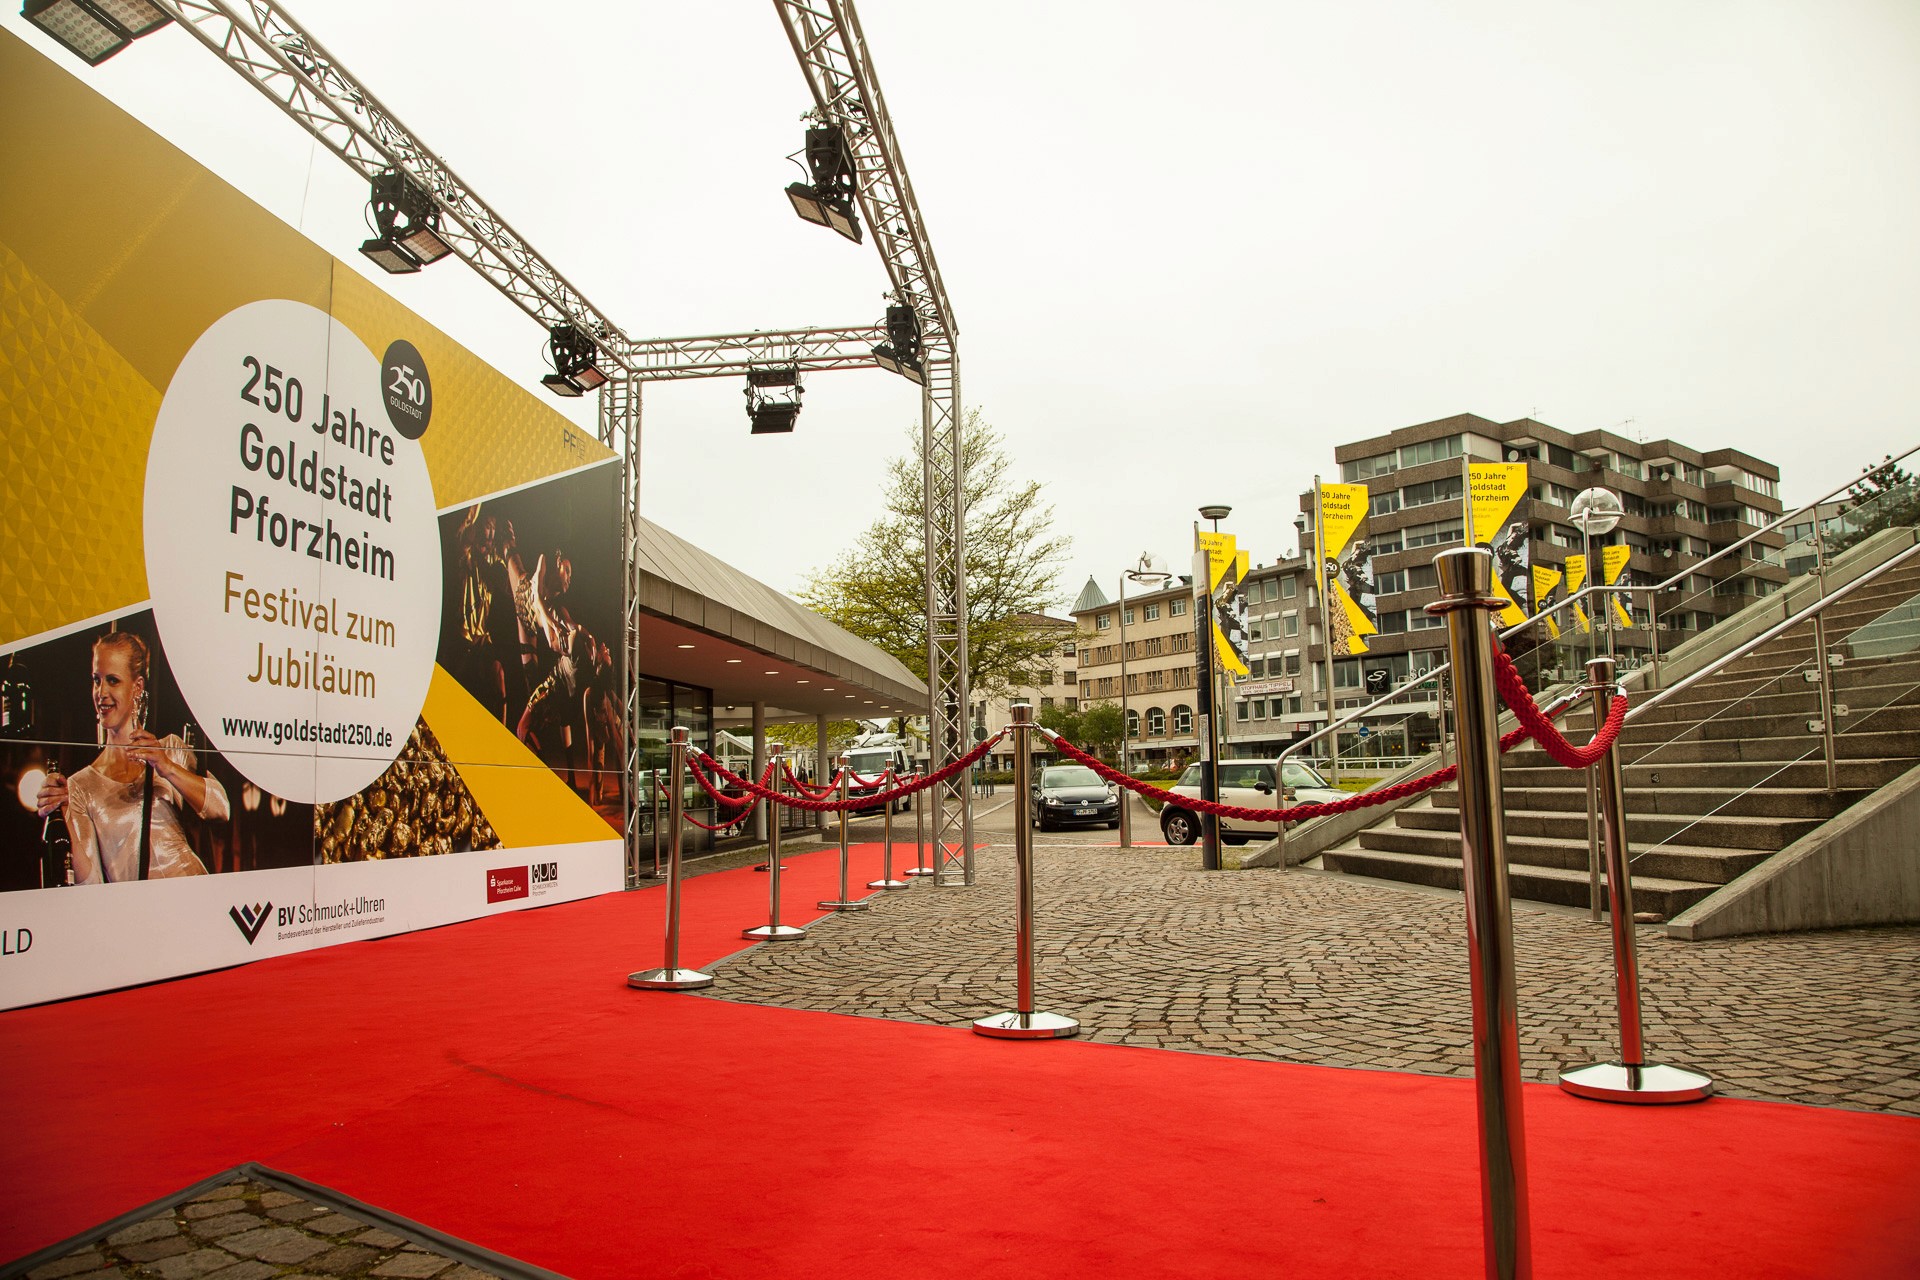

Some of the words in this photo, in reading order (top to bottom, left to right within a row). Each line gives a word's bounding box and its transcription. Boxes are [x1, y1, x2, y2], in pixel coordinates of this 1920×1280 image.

[388, 365, 426, 406] 250
[241, 355, 303, 423] 250
[311, 393, 395, 466] Jahre
[389, 395, 423, 421] GOLDSTADT
[240, 422, 392, 523] Goldstadt
[1483, 472, 1507, 480] Jahre
[1321, 491, 1331, 499] 50
[1332, 492, 1351, 500] Jahre
[1323, 512, 1354, 520] forzheim
[230, 484, 395, 582] Pforzheim
[224, 570, 339, 636] Festival
[345, 610, 396, 648] zum
[246, 642, 376, 699] Jubiläum
[222, 716, 393, 748] www.goldstadt250.de
[496, 879, 514, 887] Sparkasse
[496, 887, 514, 895] Pforzheim
[278, 905, 296, 927] BV
[298, 896, 385, 924] Schmuck+Uhren
[277, 927, 314, 941] Bundesverband
[314, 926, 322, 935] der
[322, 922, 343, 934] Hersteller
[343, 921, 351, 930] und
